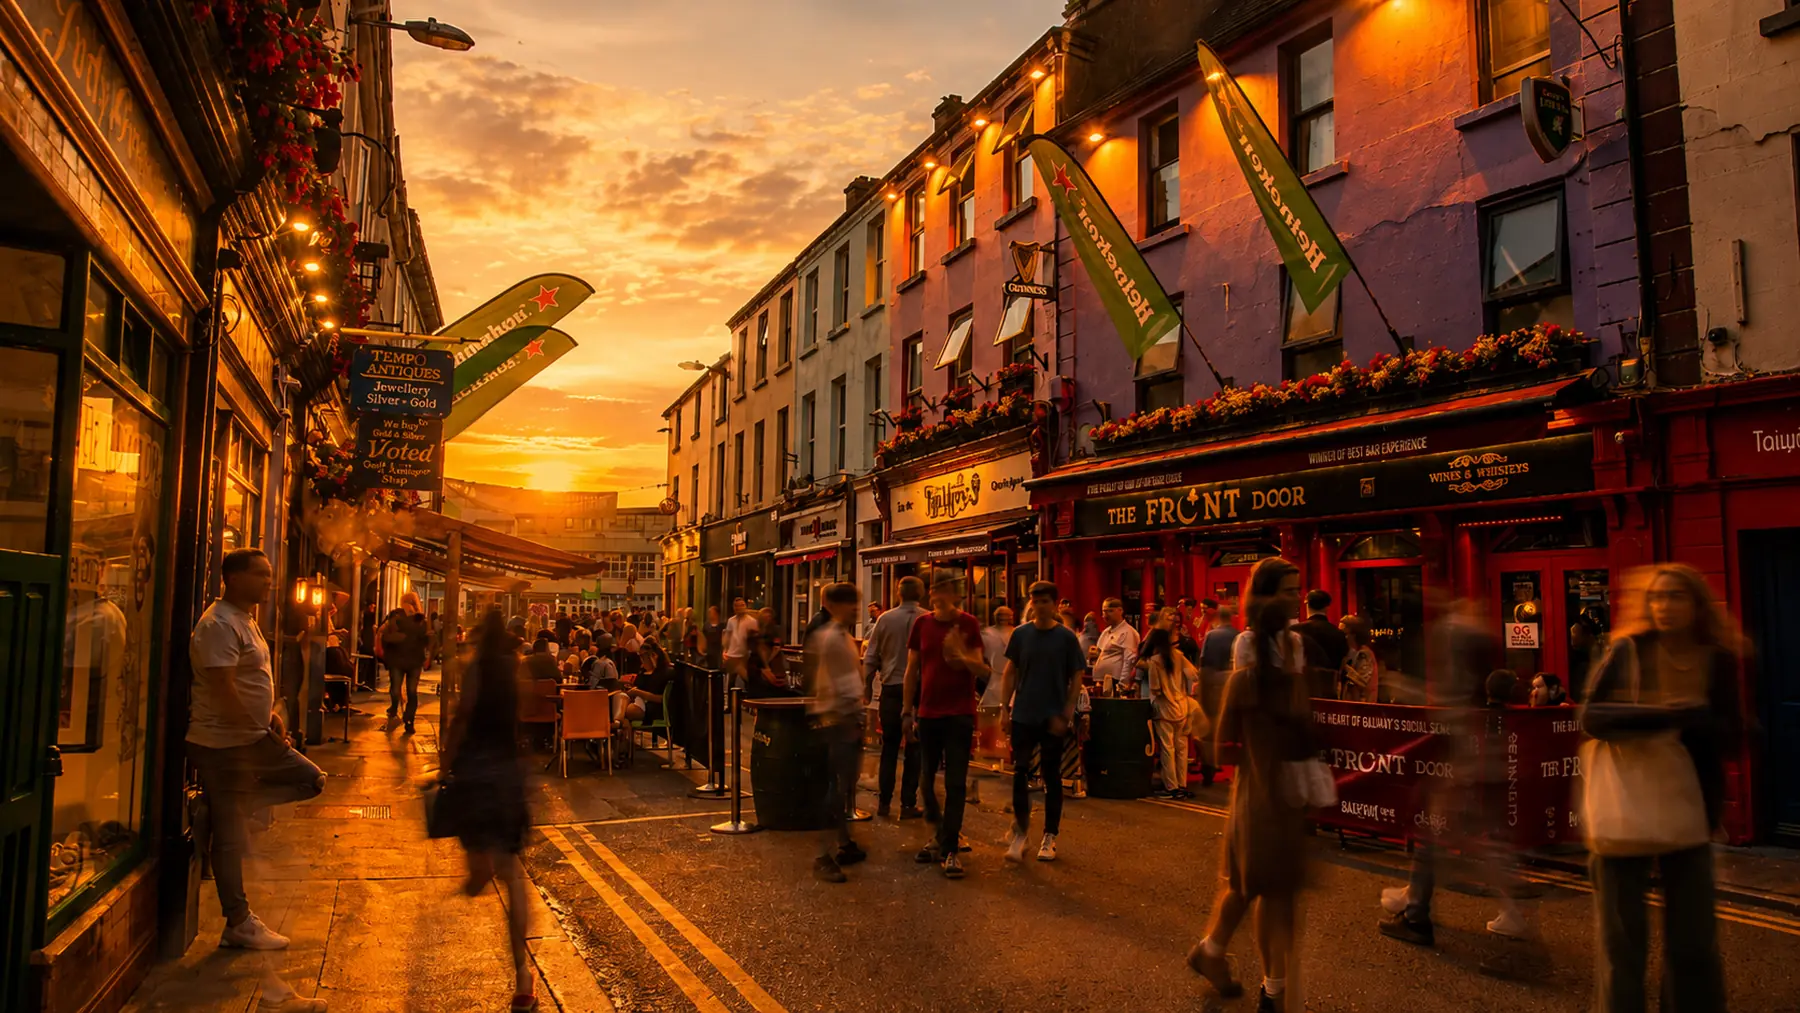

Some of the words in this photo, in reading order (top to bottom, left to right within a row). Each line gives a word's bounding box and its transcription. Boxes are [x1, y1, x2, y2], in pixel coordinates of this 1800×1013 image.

[371, 350, 427, 366] TEMPO
[366, 364, 441, 380] ANTIQUES
[373, 381, 431, 398] Jewellery
[366, 393, 400, 405] Silver
[410, 398, 437, 409] Gold
[368, 440, 435, 462] Voted
[1337, 448, 1346, 461] OF
[1347, 445, 1364, 459] BEST
[1366, 443, 1381, 456] BAR
[1381, 436, 1428, 454] EXPERIENCE
[1108, 506, 1136, 525] THE
[1146, 488, 1240, 525] FRONT
[1252, 487, 1306, 510] DOOR
[1328, 713, 1350, 726] HEART
[1351, 715, 1361, 727] OF
[1401, 720, 1429, 733] SOCIAL
[1329, 747, 1406, 776] FRONT
[1414, 759, 1454, 778] DOOR
